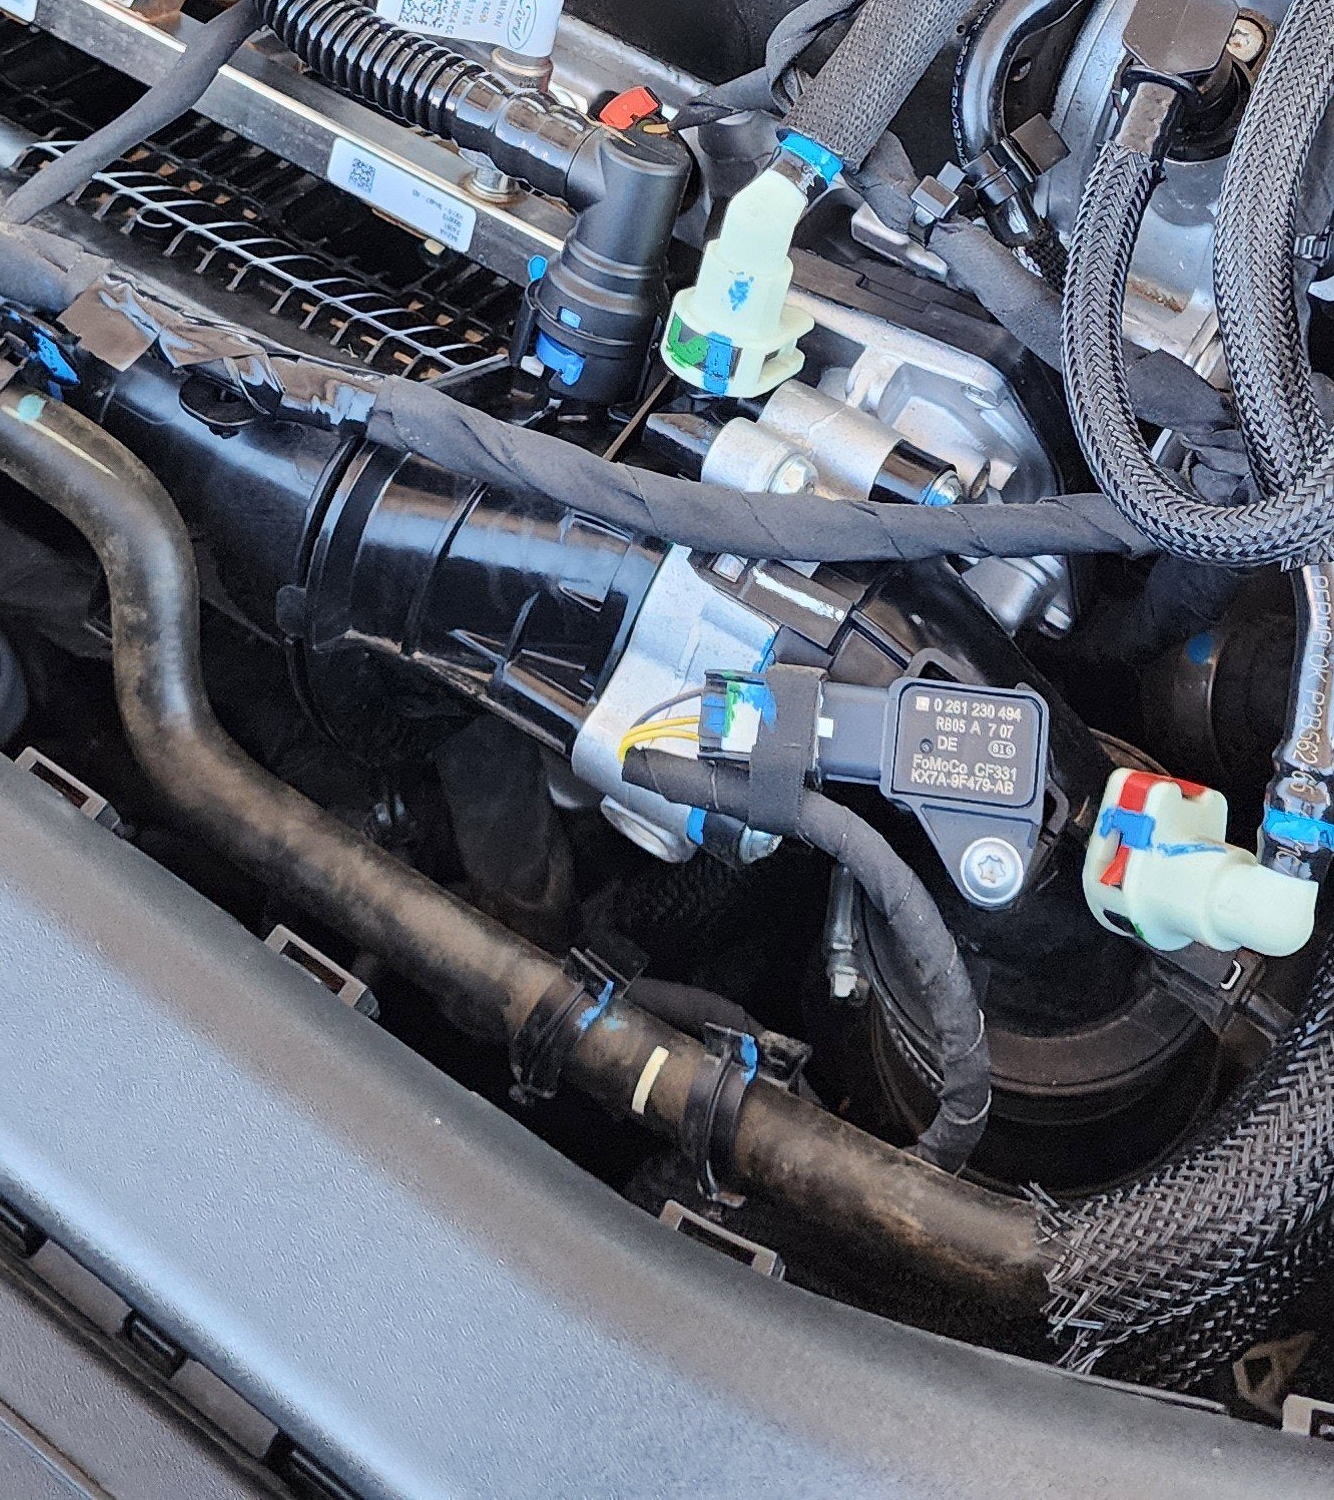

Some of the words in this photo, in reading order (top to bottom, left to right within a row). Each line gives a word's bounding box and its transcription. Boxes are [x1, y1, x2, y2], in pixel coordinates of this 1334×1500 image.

[1304, 574, 1332, 684] PERMBLOK
[934, 698, 943, 712] 0
[945, 699, 967, 716] 261
[971, 702, 995, 718] 230
[998, 706, 1022, 722] 494
[970, 721, 981, 735] A
[988, 722, 997, 737] 7
[999, 725, 1014, 738] 07
[937, 735, 958, 752] DE
[913, 754, 967, 774] FoMoCo
[974, 762, 1017, 781] CF331
[911, 768, 1014, 795] KX7A-9F479-AB
